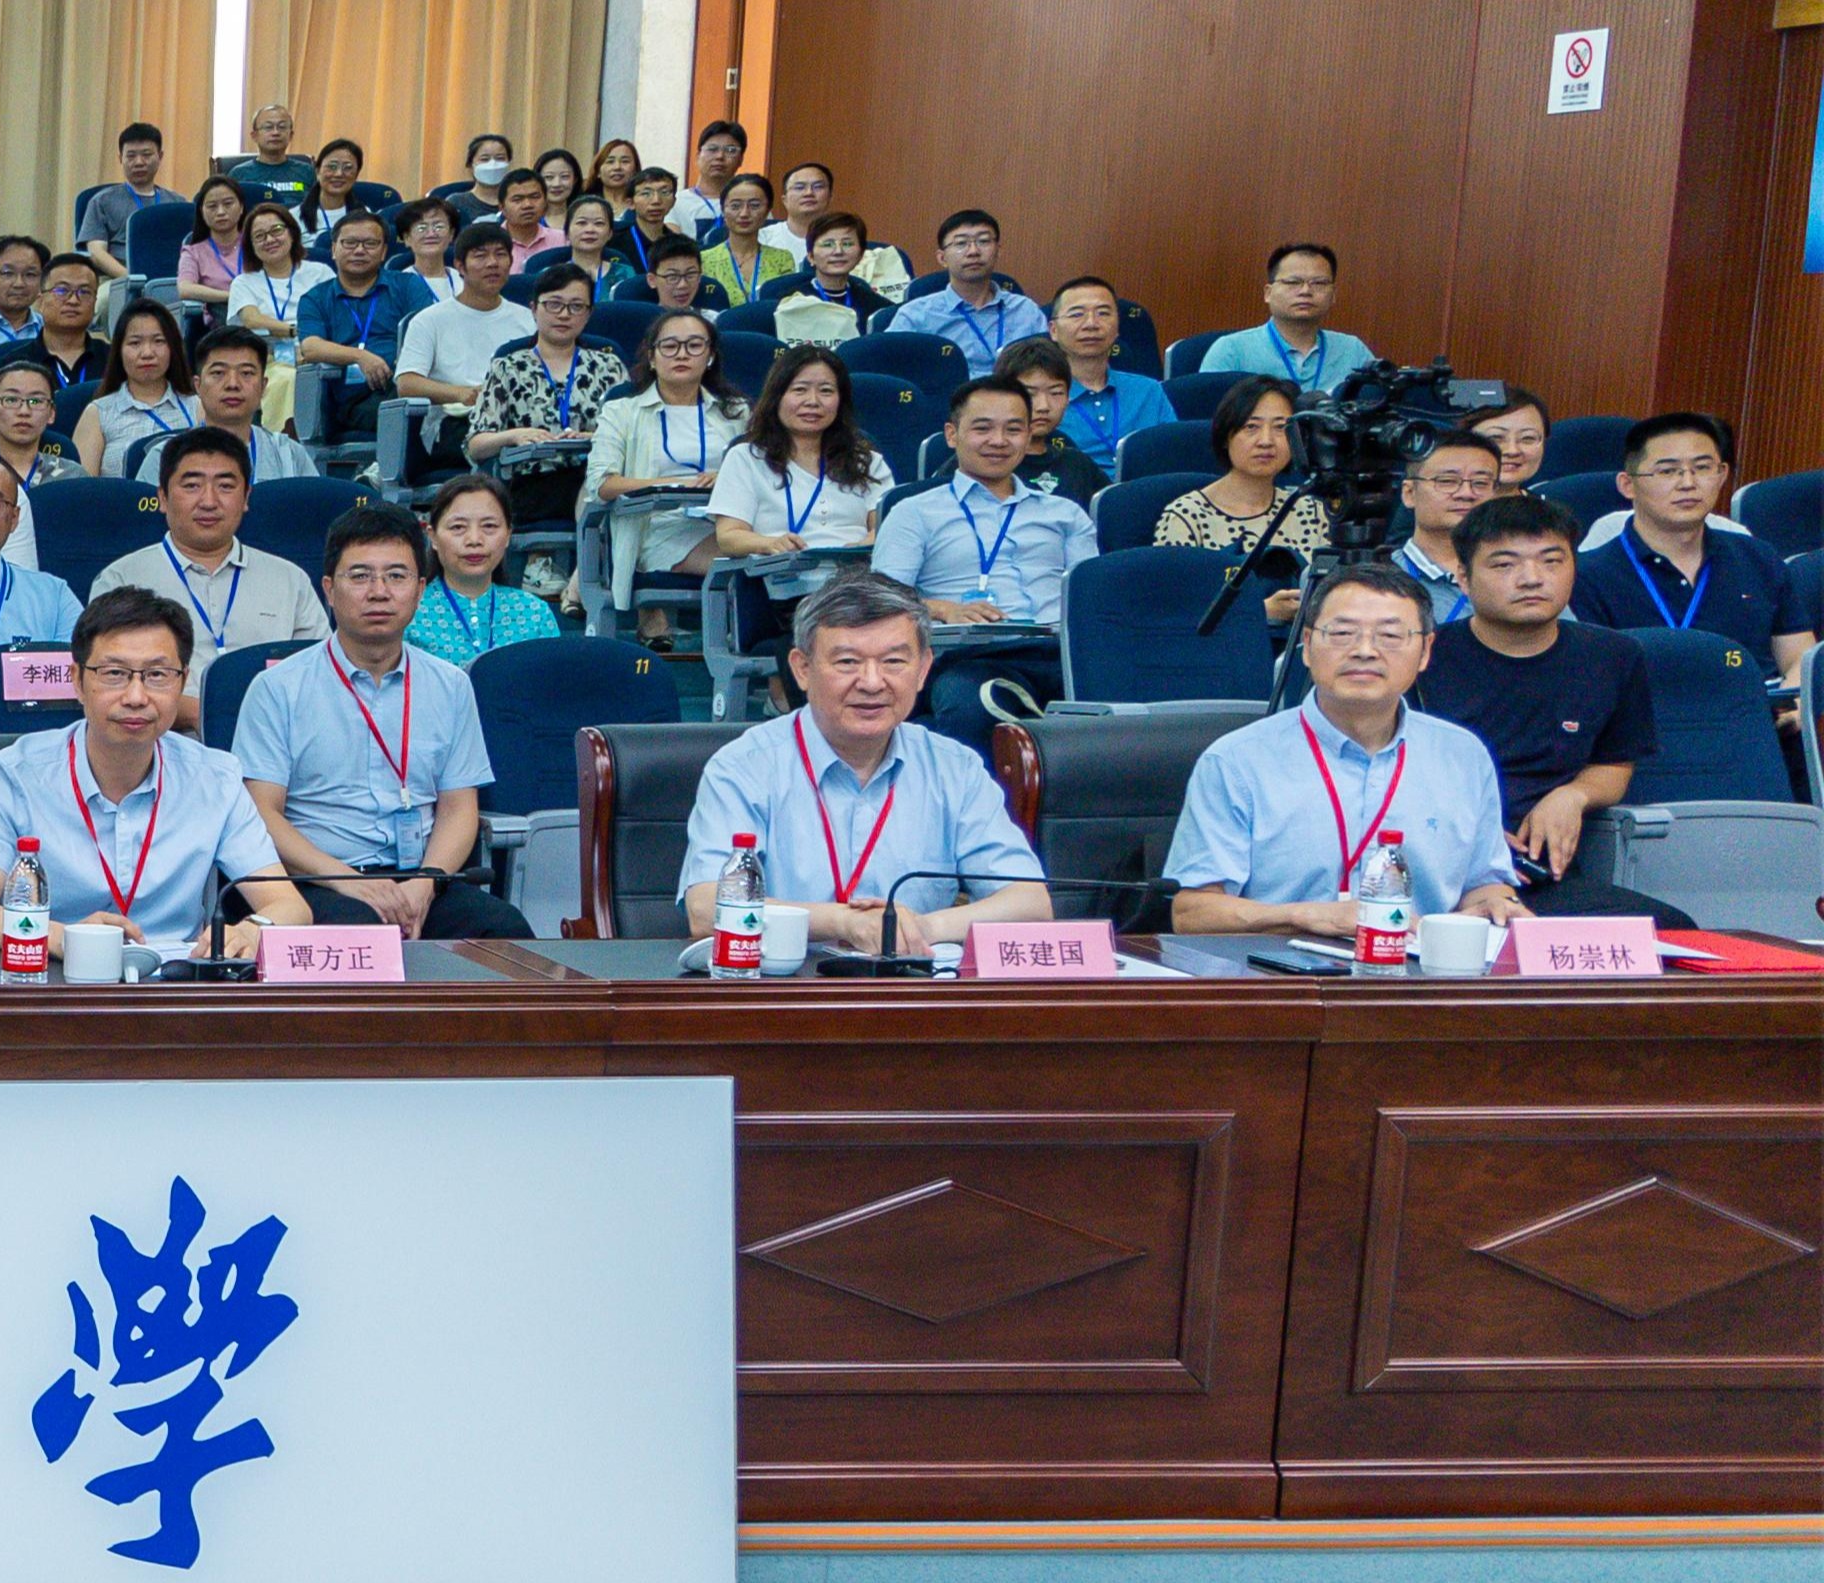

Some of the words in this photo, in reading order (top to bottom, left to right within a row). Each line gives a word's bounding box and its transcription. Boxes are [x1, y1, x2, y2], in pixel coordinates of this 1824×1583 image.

[900, 390, 913, 403] 15
[137, 496, 159, 512] 09
[355, 496, 368, 507] 11
[635, 658, 650, 674] 11
[1725, 650, 1742, 667] 15
[287, 944, 375, 973] 谭方正
[999, 940, 1085, 968] 陈建国
[1549, 944, 1636, 971] 杨崇林
